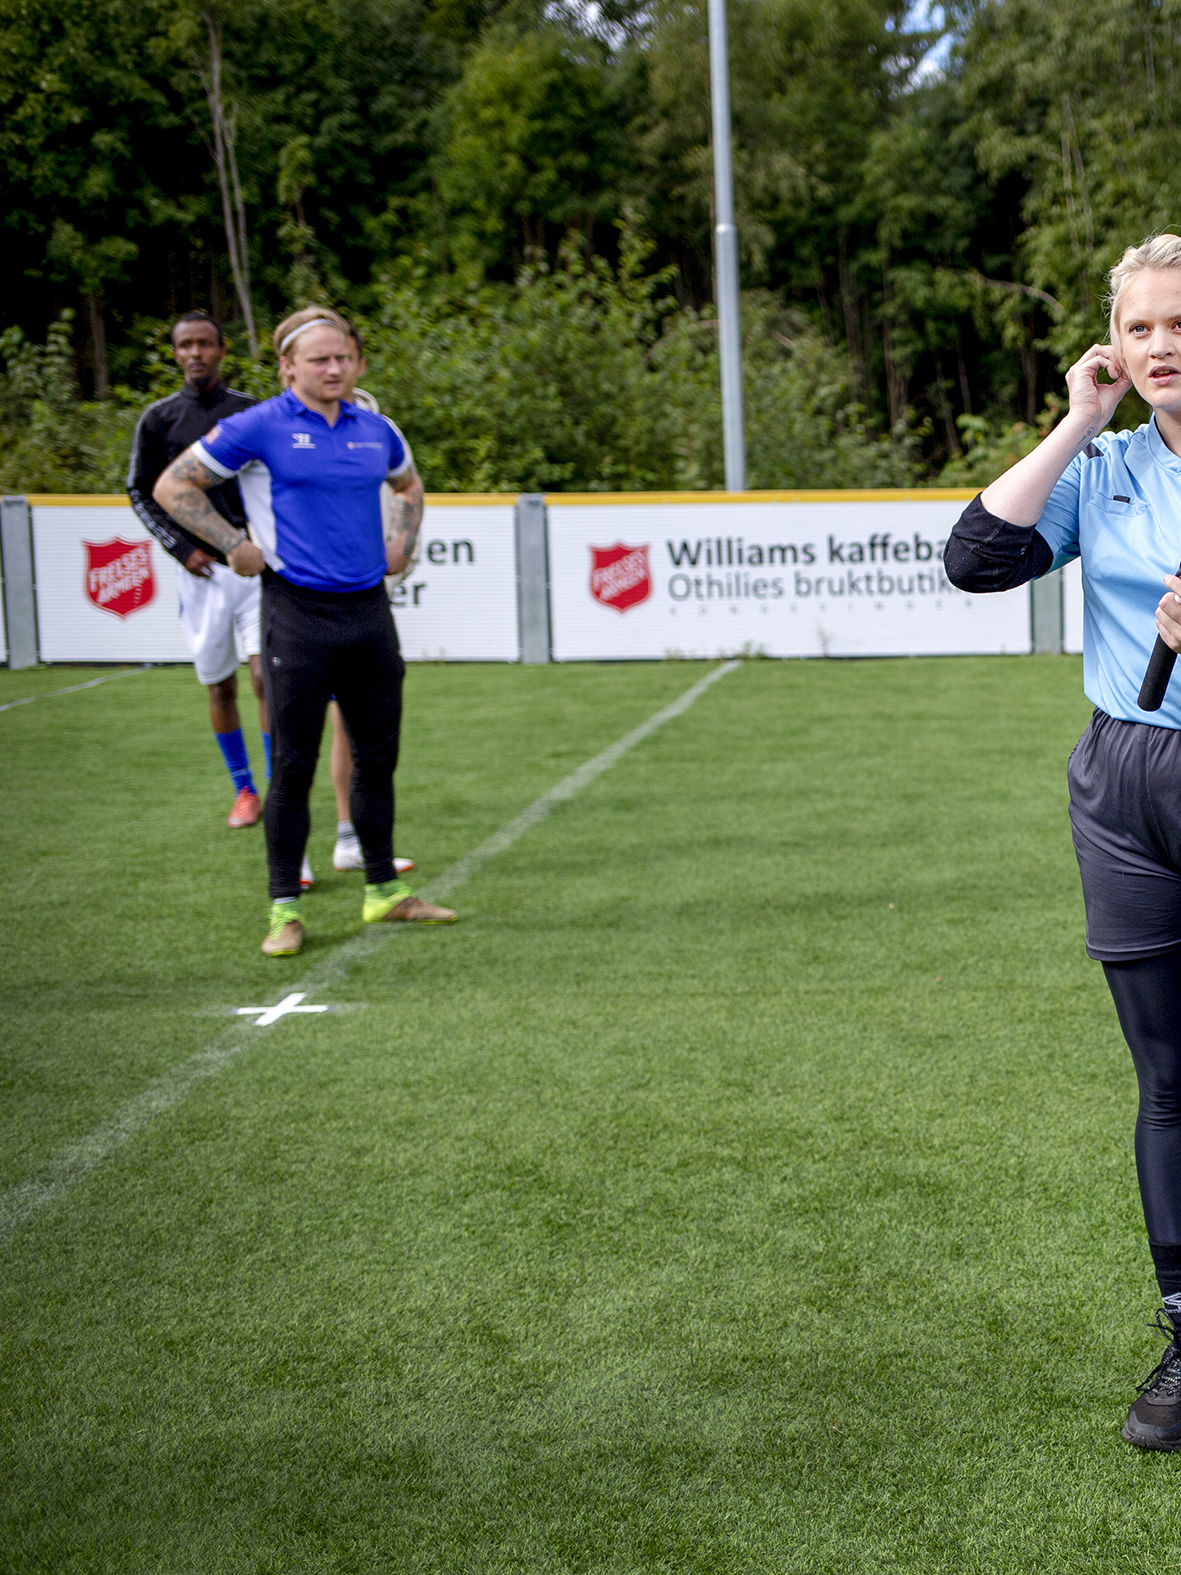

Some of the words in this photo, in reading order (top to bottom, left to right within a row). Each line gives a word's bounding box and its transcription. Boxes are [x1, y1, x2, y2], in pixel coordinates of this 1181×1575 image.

[667, 536, 817, 567] Williams
[668, 571, 784, 602] Othilies
[795, 567, 962, 597] bruktbutik
